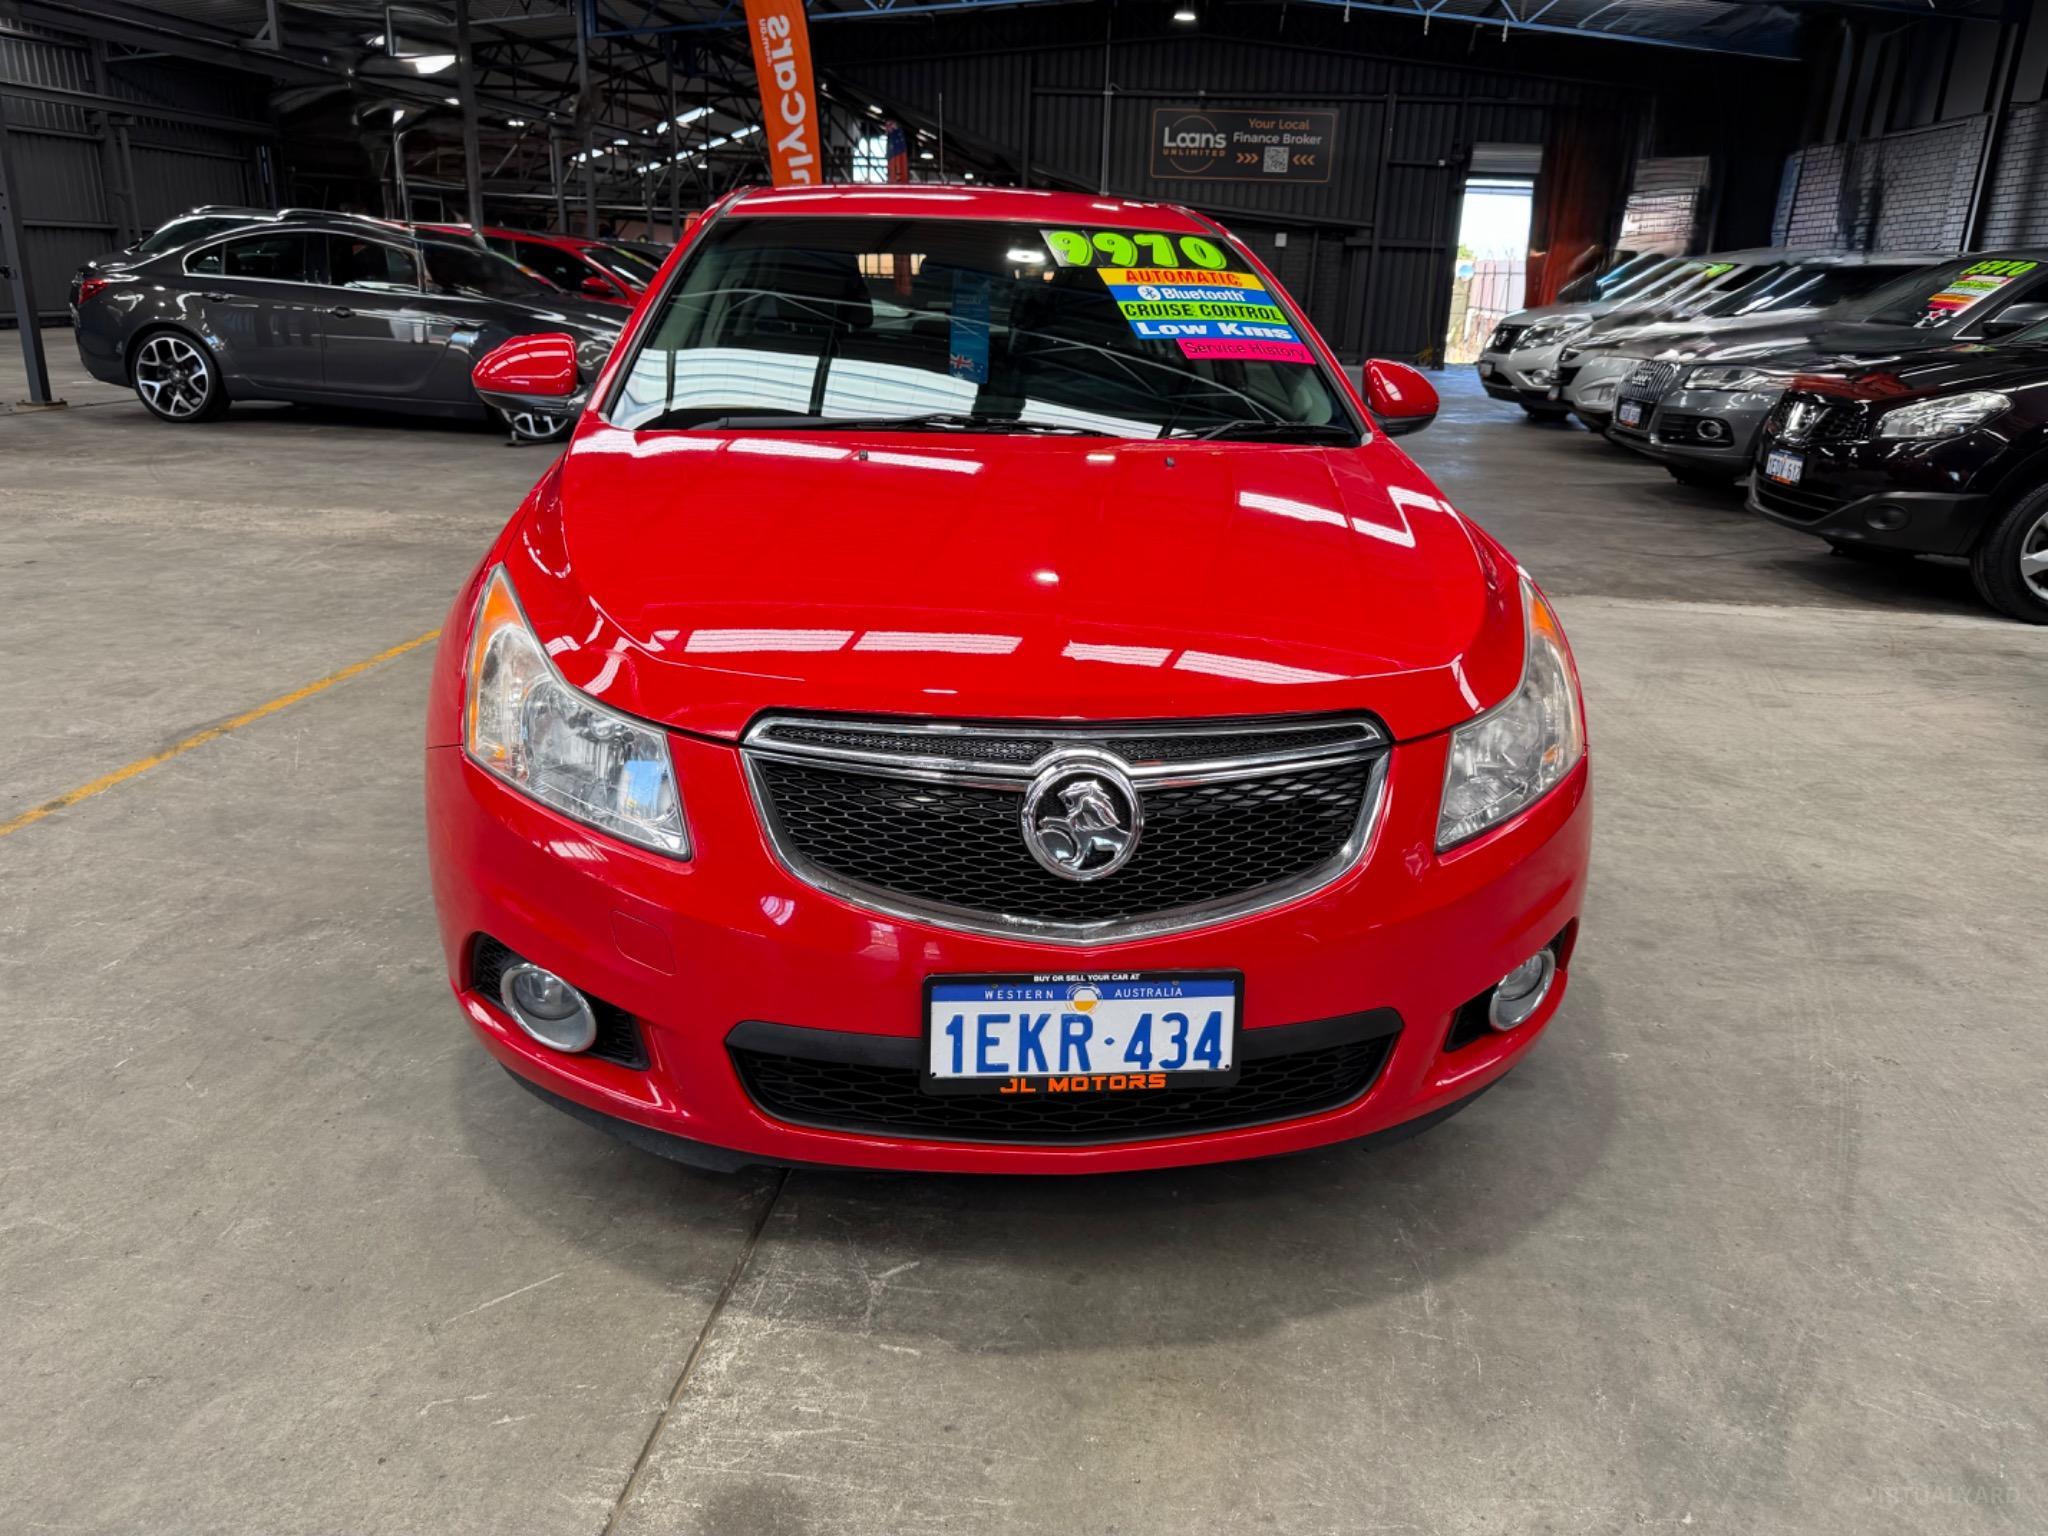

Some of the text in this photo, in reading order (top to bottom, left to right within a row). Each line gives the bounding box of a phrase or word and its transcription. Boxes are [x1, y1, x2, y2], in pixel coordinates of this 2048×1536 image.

[1248, 118, 1310, 130] Your Local
[1163, 126, 1227, 148] Loans
[1233, 132, 1322, 145] Finance Broker
[1162, 149, 1226, 157] UNLIMITED
[1048, 231, 1227, 270] 9970
[1125, 269, 1243, 287] AUTOMATIC
[1125, 303, 1282, 321] CRUISE CONTROL
[1138, 322, 1294, 340] Low Kms
[1184, 341, 1306, 360] Service History
[1033, 975, 1051, 983] BUY
[985, 986, 1183, 1000] WESTERN AUSTRALIA
[1000, 1073, 1167, 1094] JL MOTORS
